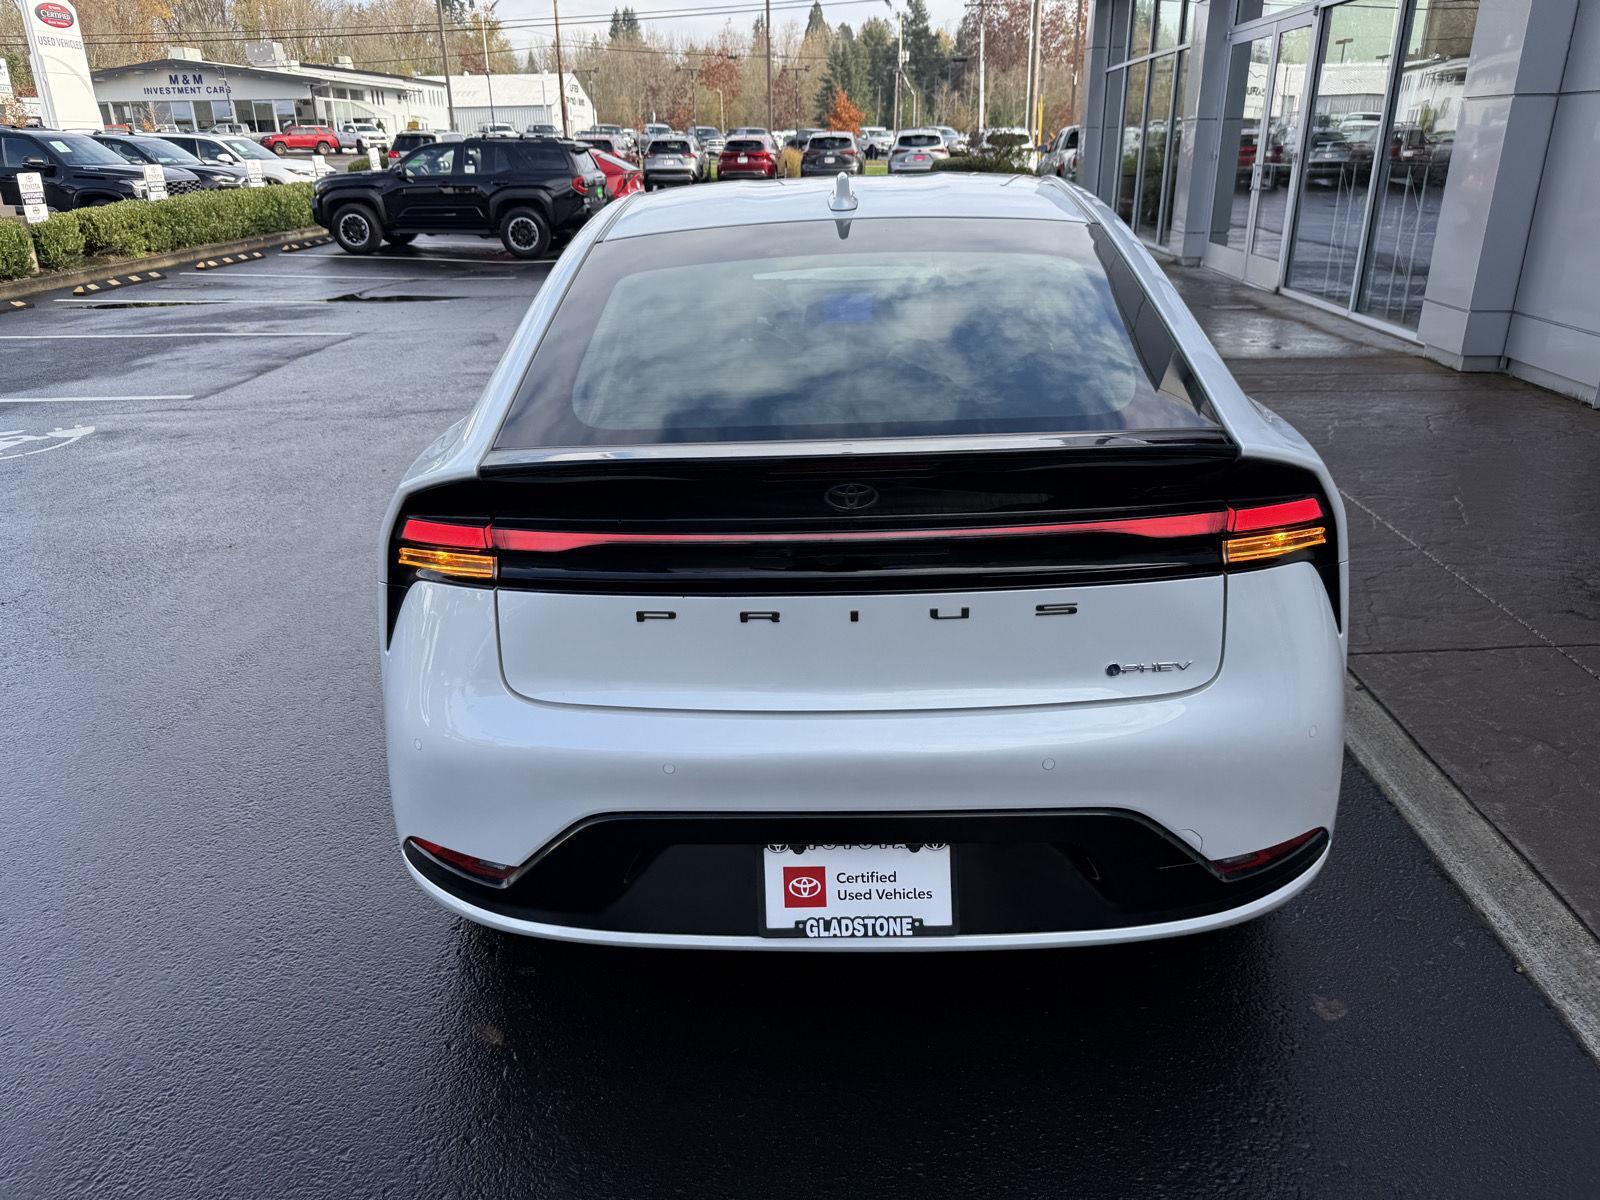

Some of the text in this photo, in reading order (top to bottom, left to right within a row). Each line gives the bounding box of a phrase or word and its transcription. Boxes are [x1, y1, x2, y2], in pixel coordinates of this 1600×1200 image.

[37, 35, 83, 50] USED VEHICLES
[169, 74, 203, 84] M & M
[143, 86, 232, 95] INVESTMENT CARS
[636, 602, 1078, 622] PRIUS
[1121, 660, 1192, 674] PHEV
[836, 871, 897, 884] Certified
[837, 887, 933, 900] Used Vehicles
[805, 917, 913, 938] GLADSTONE
